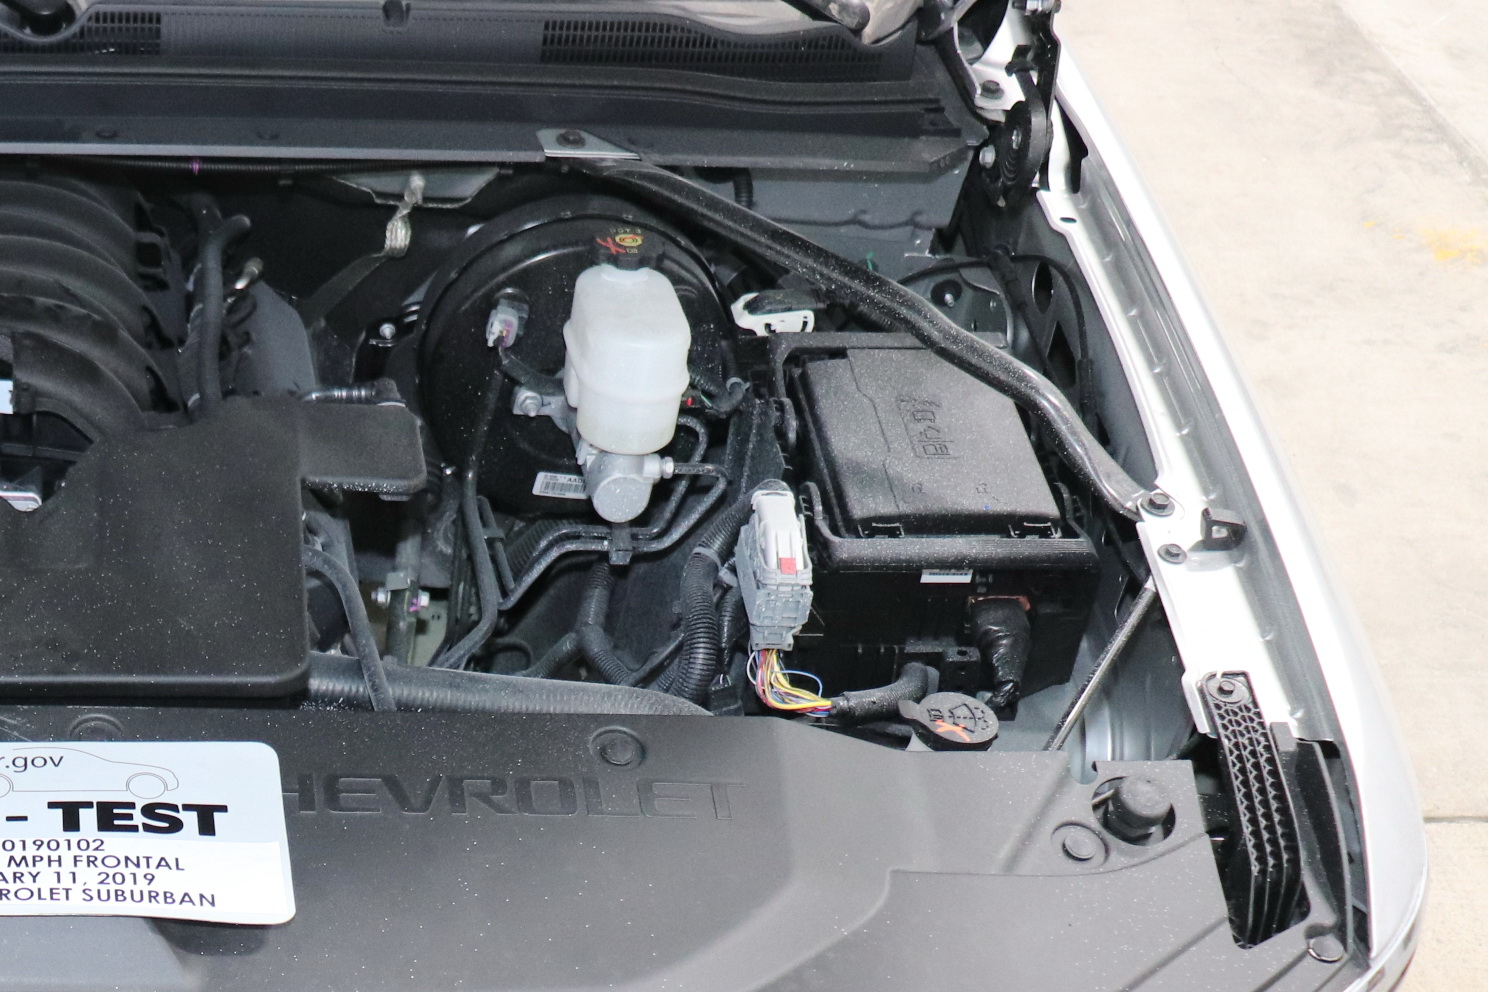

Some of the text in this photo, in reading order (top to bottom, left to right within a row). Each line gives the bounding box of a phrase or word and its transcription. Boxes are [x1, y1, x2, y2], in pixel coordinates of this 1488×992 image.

[282, 774, 746, 820] HEVROLET
[48, 801, 228, 837] TEST
[6, 854, 66, 868] MPH
[74, 855, 186, 872] FRONTAL
[53, 872, 87, 887] 11,
[97, 872, 155, 886] 2019
[82, 888, 216, 908] SUBURBAN
